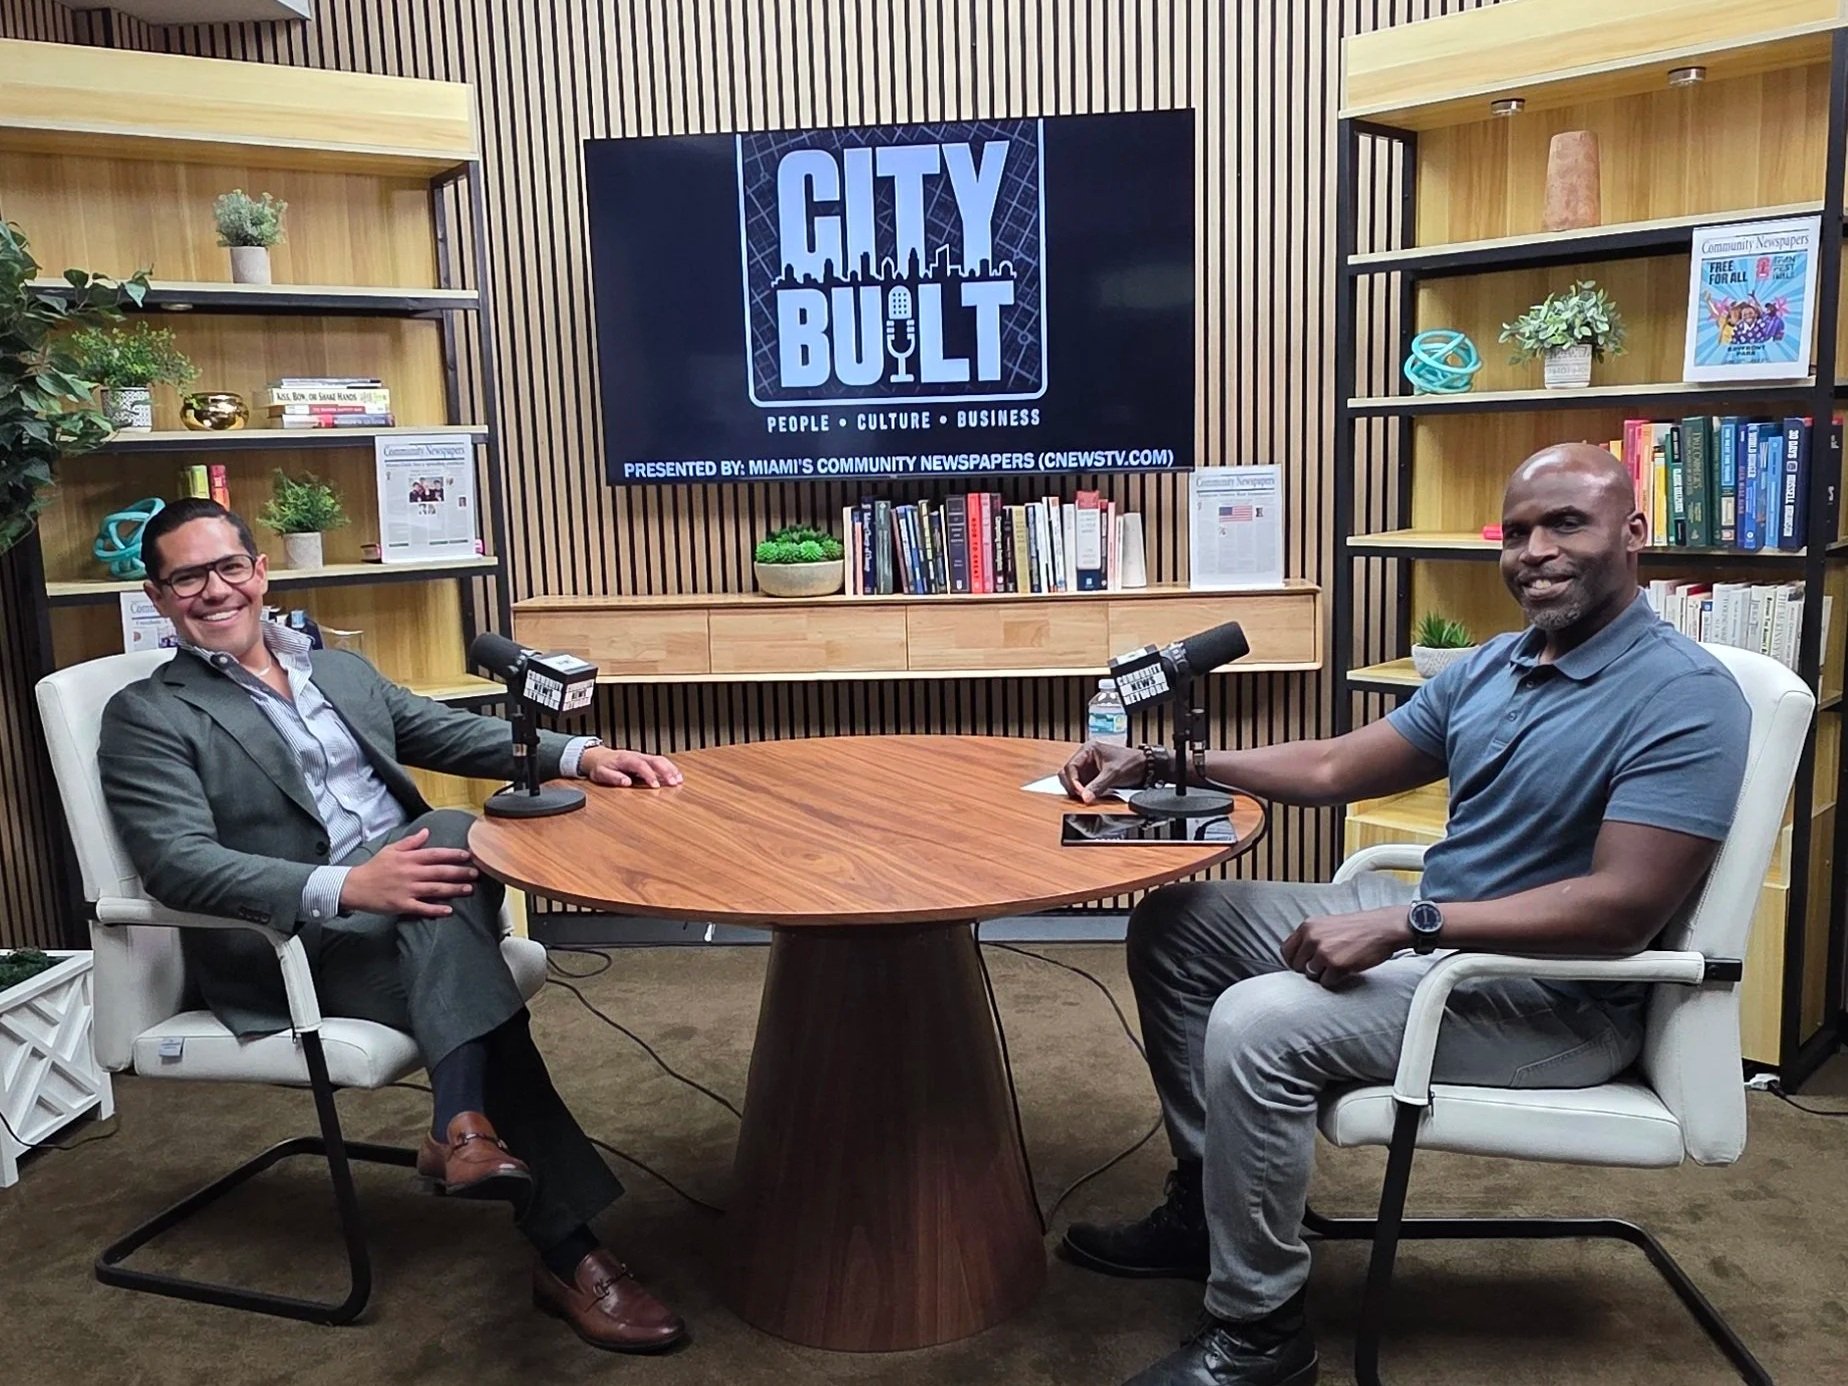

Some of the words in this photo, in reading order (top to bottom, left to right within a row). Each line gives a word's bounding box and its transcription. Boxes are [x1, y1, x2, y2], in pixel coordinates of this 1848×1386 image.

[776, 141, 1010, 283] CITY
[1701, 237, 1752, 254] Community
[1756, 234, 1809, 249] Newspapers
[1709, 260, 1735, 273] FREE
[1709, 273, 1729, 285] FOR
[1730, 271, 1748, 283] ALL
[767, 415, 830, 433] PEOPLE
[857, 411, 931, 430] CULTURE
[957, 408, 1040, 428] BUSINESS
[624, 460, 717, 478] PRESENTED
[720, 460, 745, 476] BY:
[749, 458, 813, 475] MIAMI'S
[817, 454, 916, 474] COMMUNITY
[920, 452, 1035, 472] NEWSPAPERS
[1038, 449, 1174, 470] (CNEWSTV.COM)
[1131, 675, 1156, 691] NEWS
